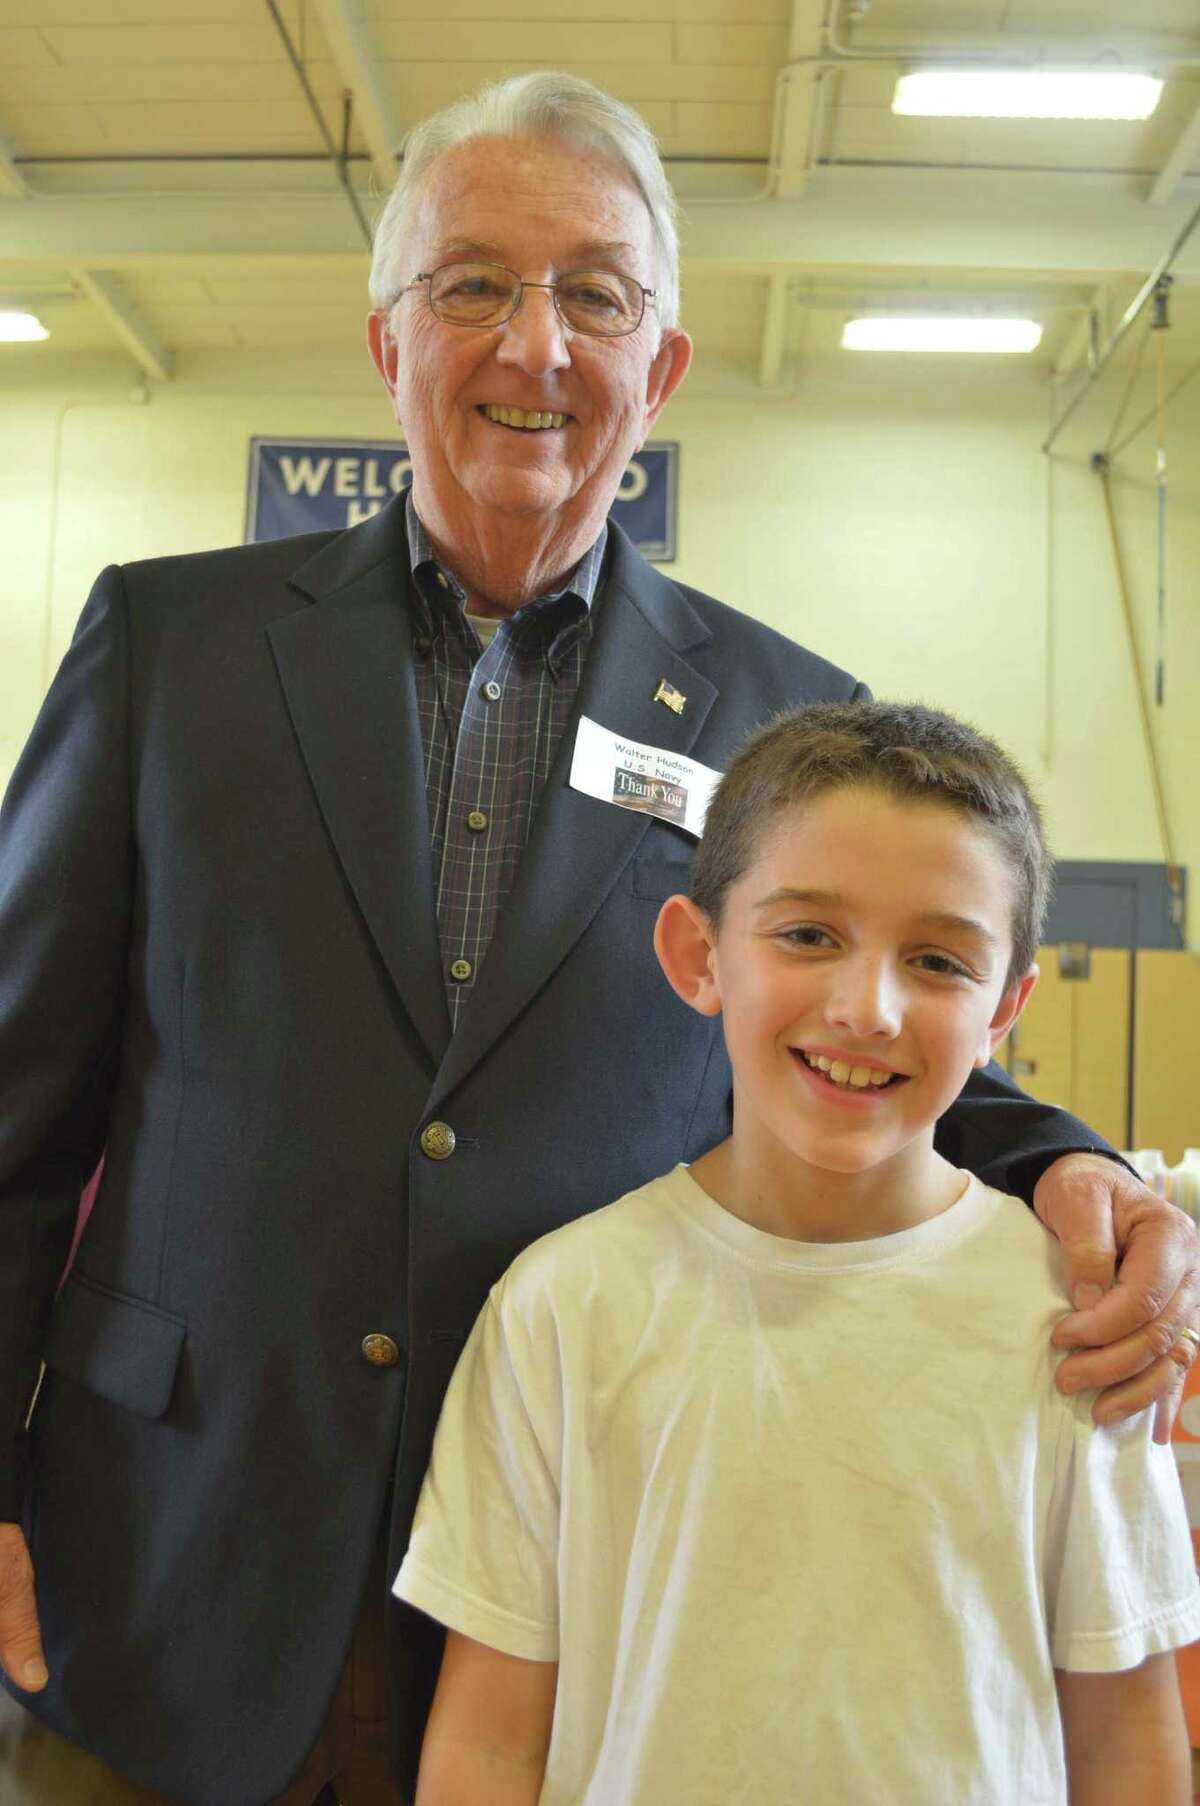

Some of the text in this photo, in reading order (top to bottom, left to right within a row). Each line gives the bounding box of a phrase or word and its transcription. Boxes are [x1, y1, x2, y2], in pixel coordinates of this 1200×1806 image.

[615, 743, 694, 776] Walter Hudson
[655, 768, 682, 784] Navy
[617, 772, 682, 808] Thank You
